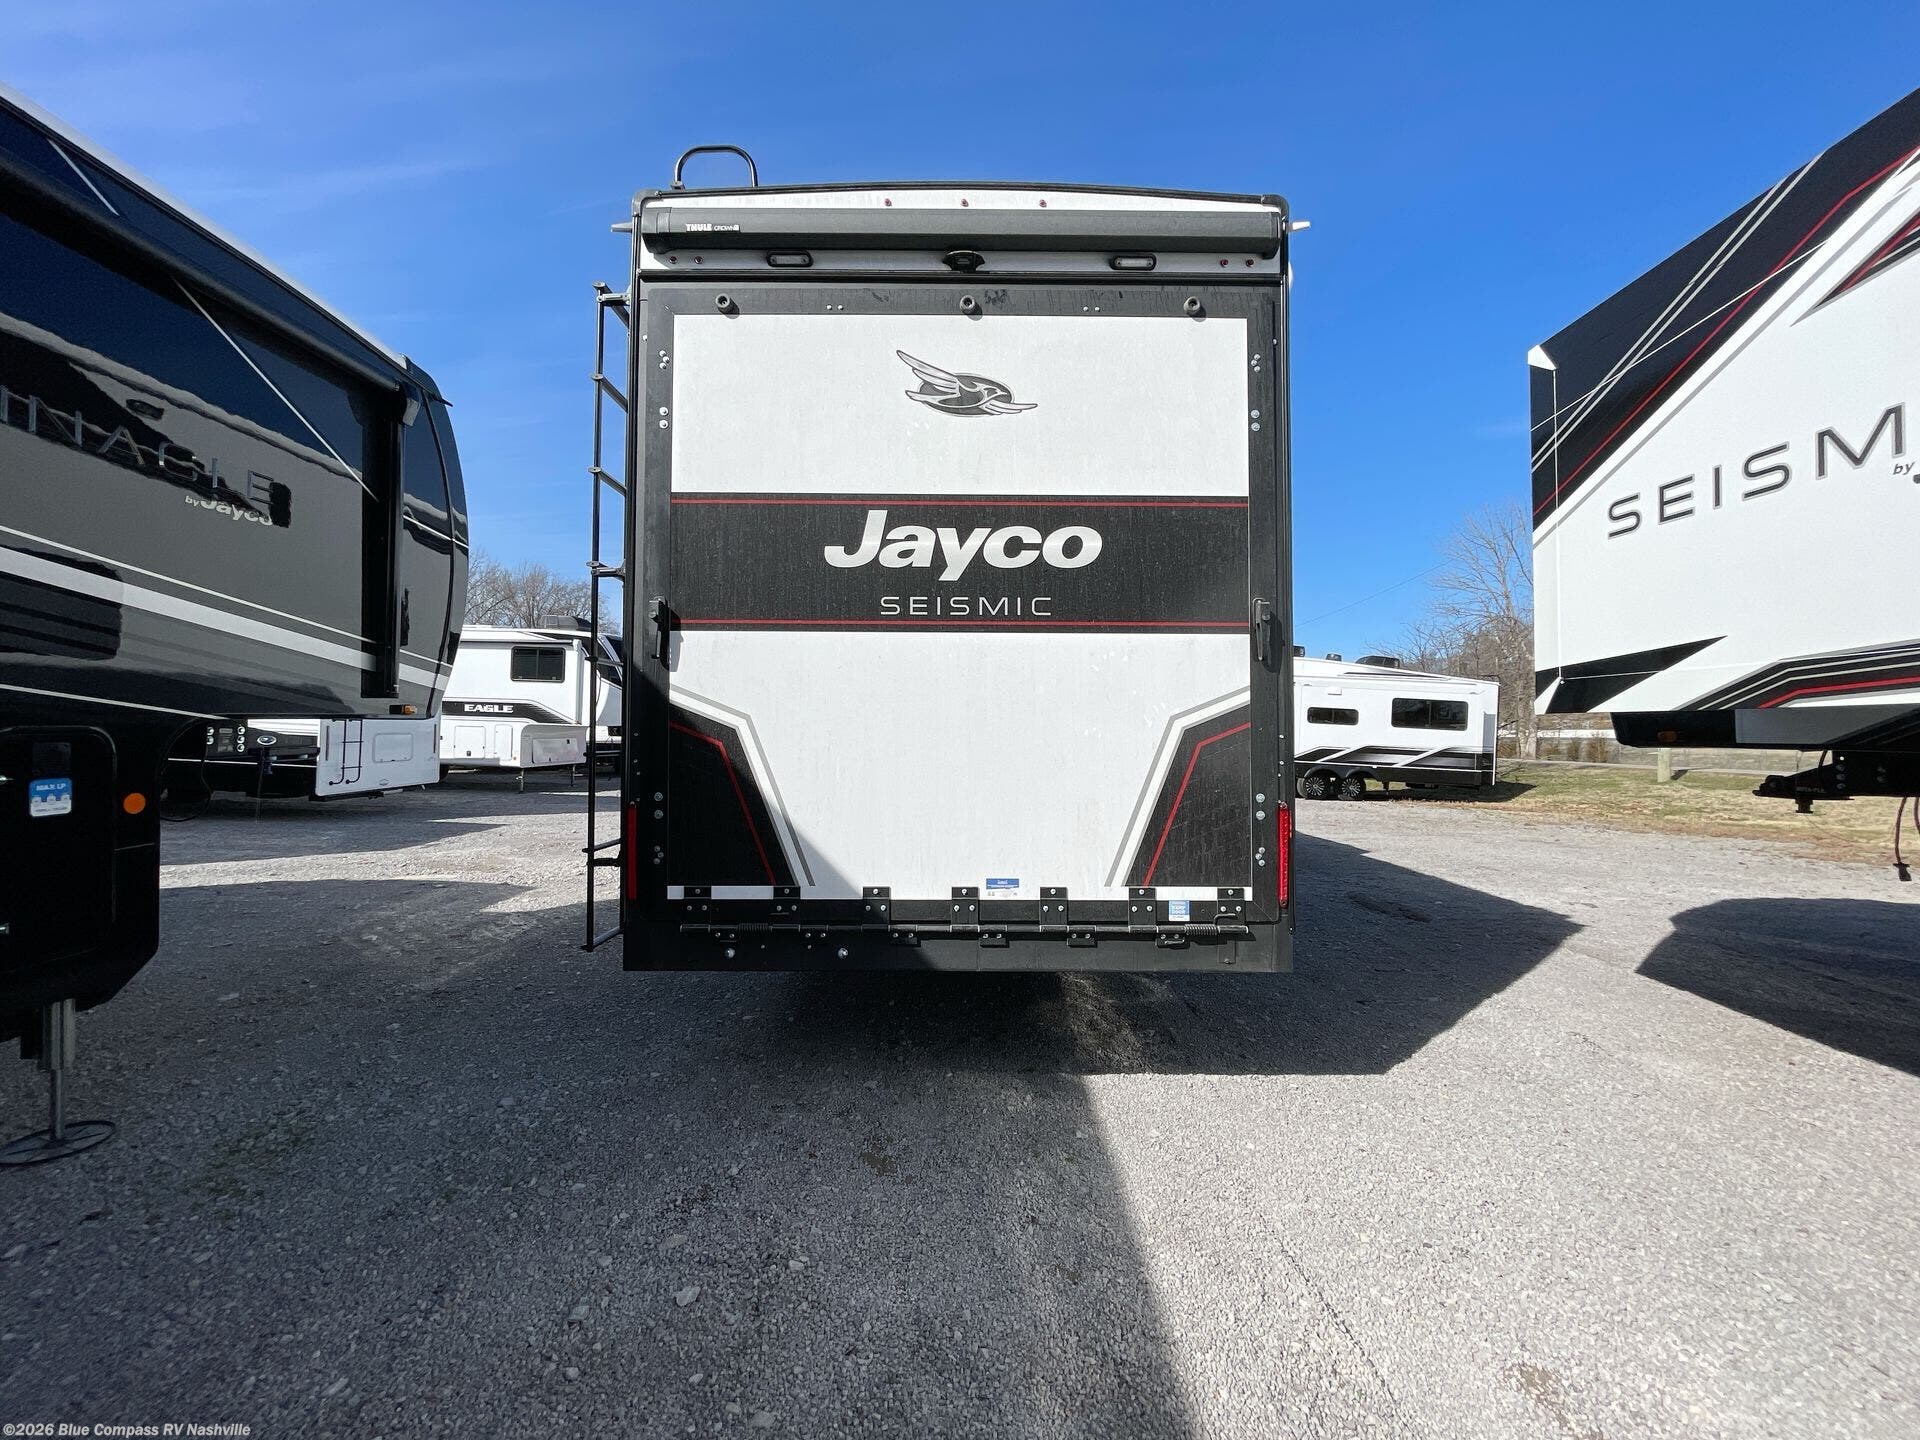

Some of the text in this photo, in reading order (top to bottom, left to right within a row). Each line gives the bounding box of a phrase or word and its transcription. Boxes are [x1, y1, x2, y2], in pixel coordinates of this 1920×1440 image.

[685, 223, 712, 232] THULE
[1607, 401, 1905, 539] SEISM
[1892, 461, 1915, 475] by
[185, 494, 274, 526] by Jayco
[824, 509, 1103, 581] Jayco
[880, 596, 1051, 616] SEISMIC
[464, 703, 513, 713] EAGLE
